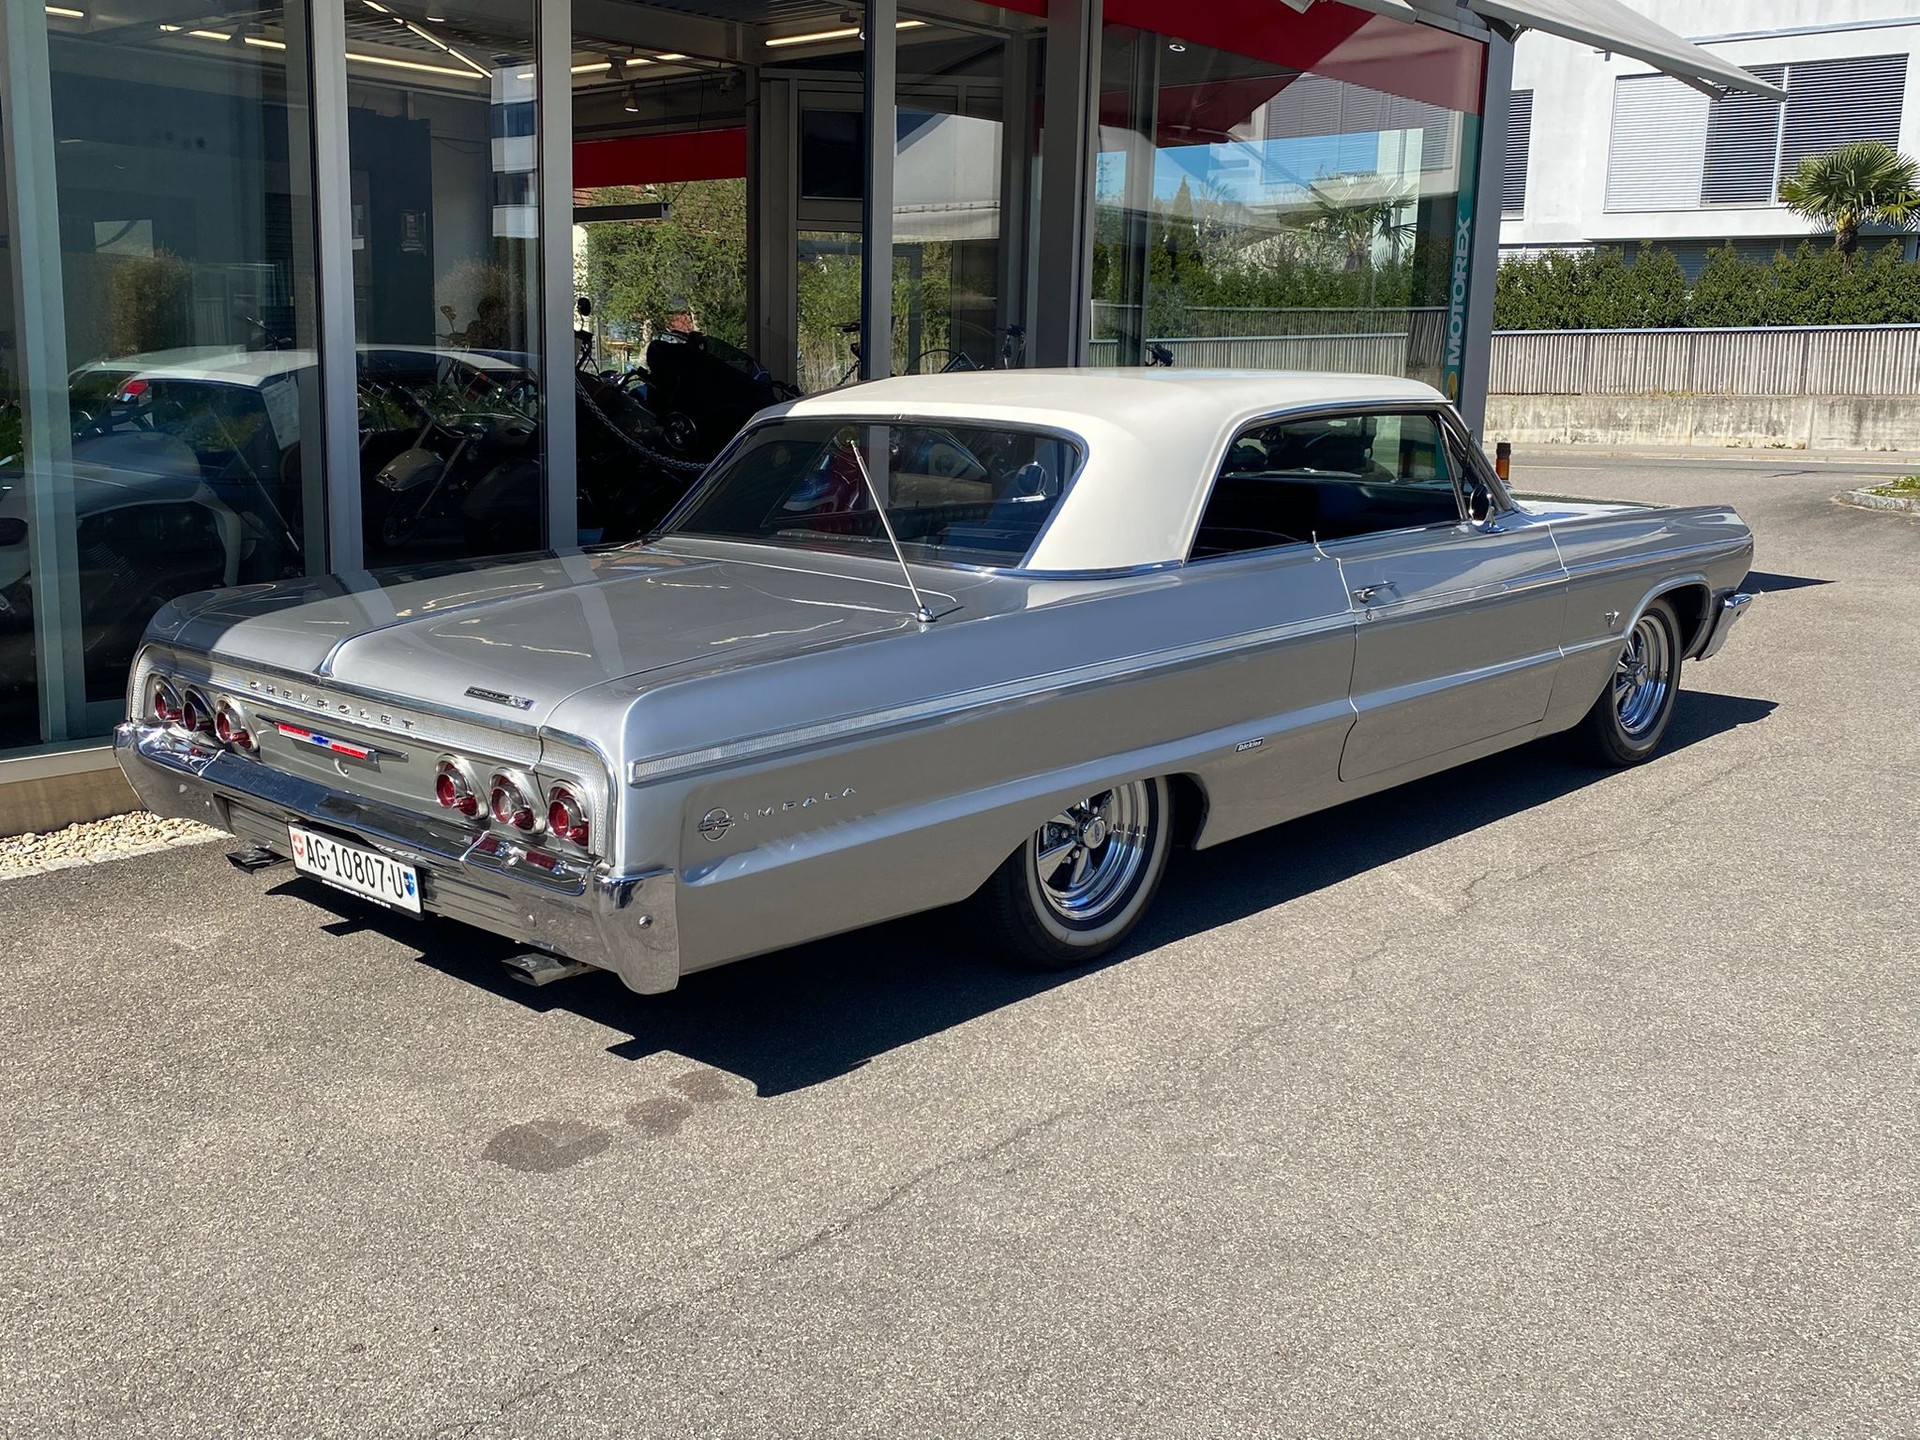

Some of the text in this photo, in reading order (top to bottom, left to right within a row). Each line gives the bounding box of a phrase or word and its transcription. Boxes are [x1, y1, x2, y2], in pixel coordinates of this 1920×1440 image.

[1447, 216, 1471, 366] MOTOREX
[250, 681, 414, 730] CHEVROLET
[743, 787, 857, 821] IMPALA
